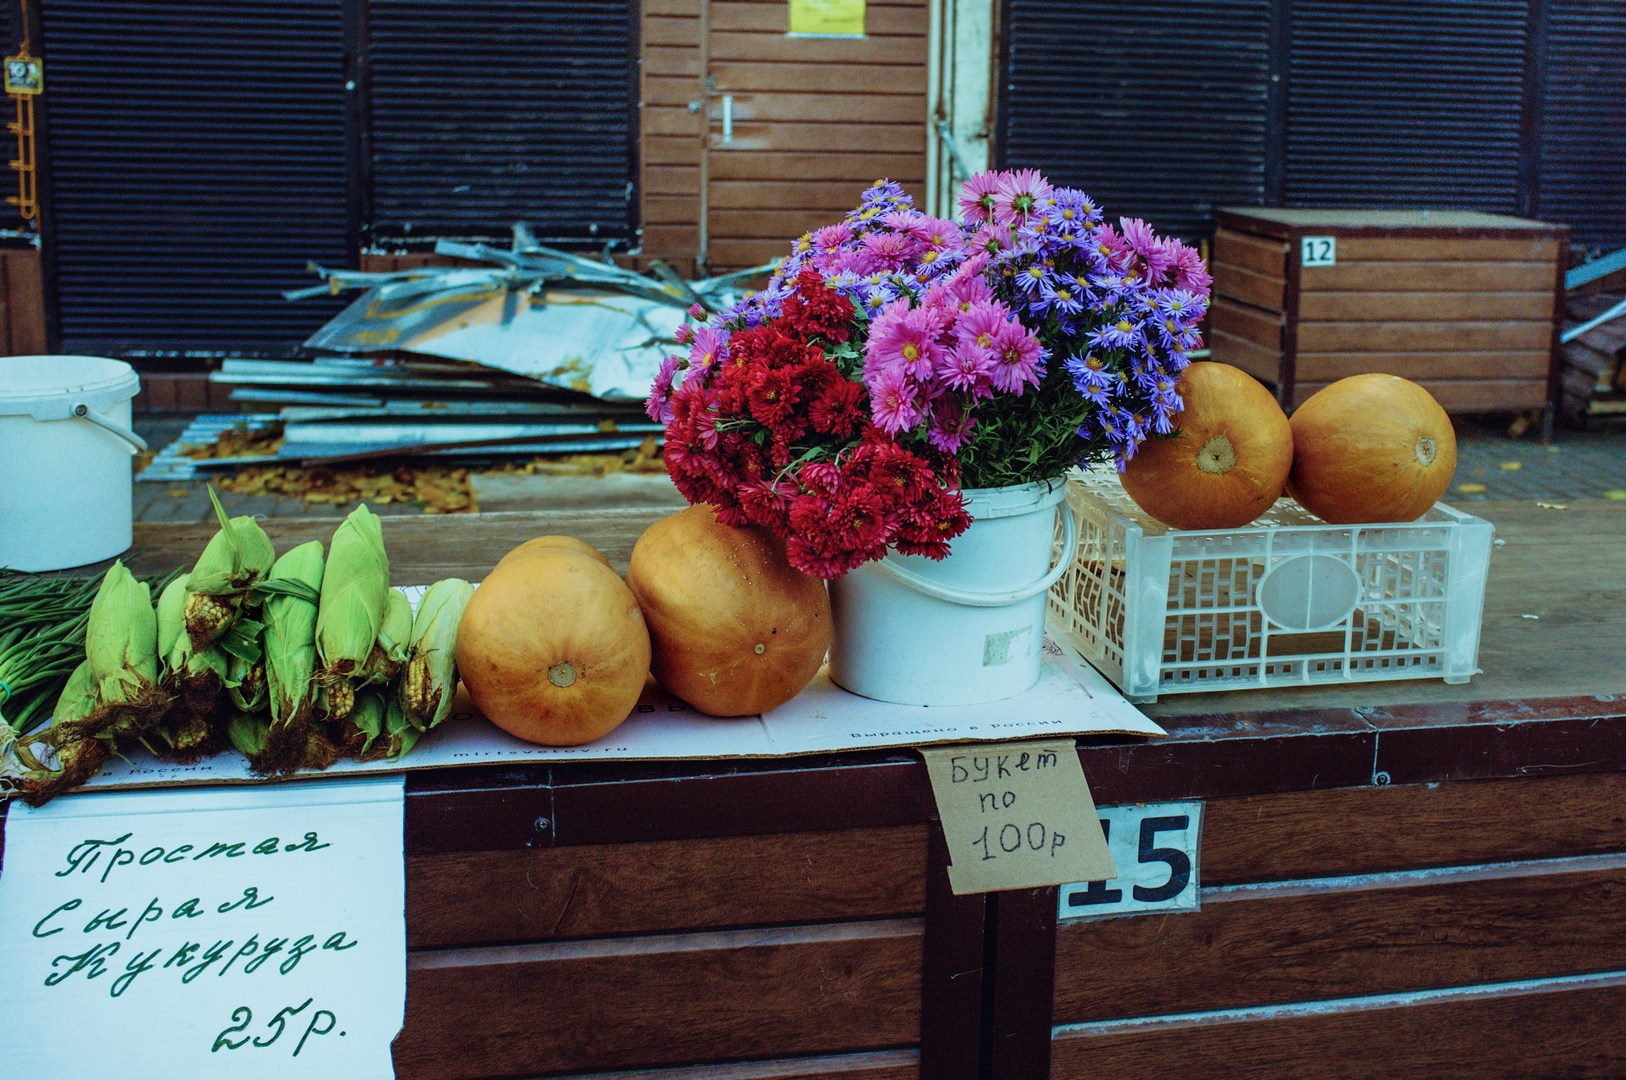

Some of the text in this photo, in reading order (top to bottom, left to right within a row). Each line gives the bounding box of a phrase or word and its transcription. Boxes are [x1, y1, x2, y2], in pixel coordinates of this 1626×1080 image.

[1306, 240, 1331, 262] 12
[849, 726, 958, 739] Выращено
[54, 831, 331, 884] Простая
[32, 886, 274, 940] Сырая
[44, 930, 359, 997] Кукуруза
